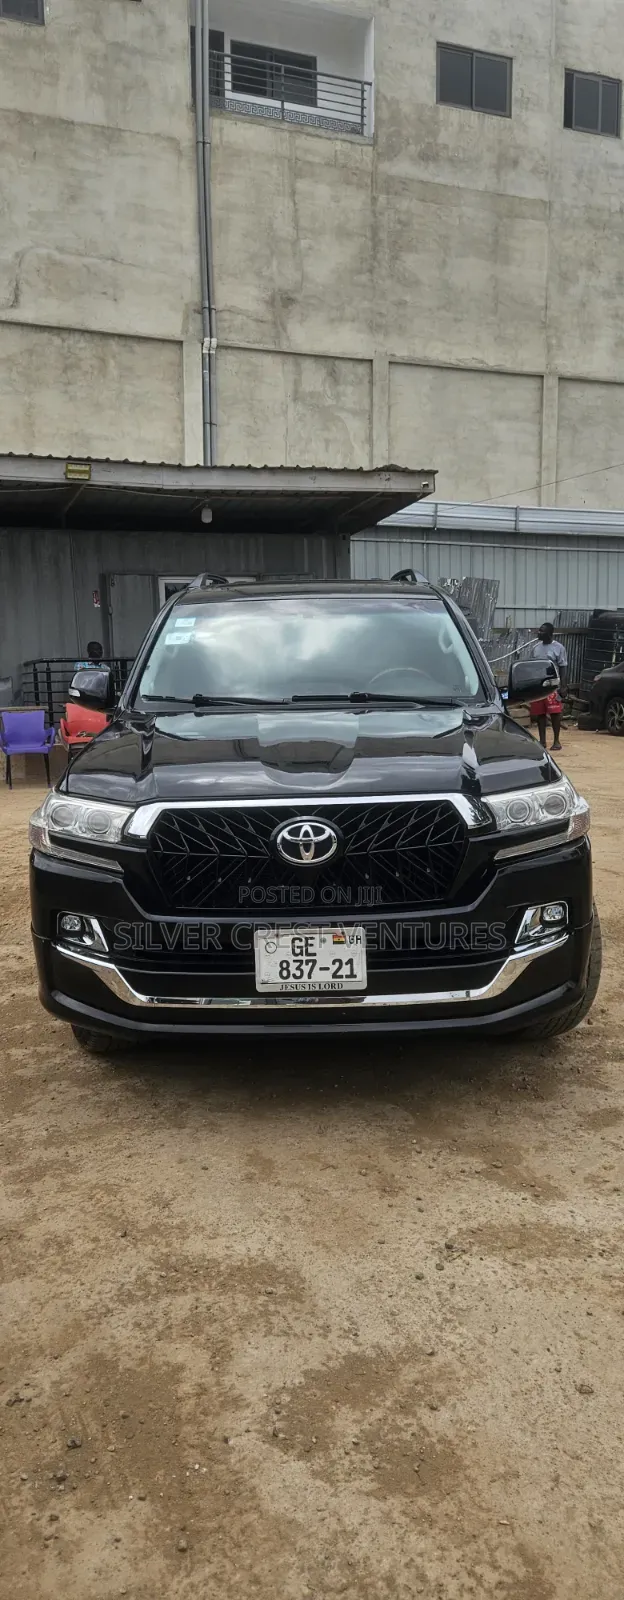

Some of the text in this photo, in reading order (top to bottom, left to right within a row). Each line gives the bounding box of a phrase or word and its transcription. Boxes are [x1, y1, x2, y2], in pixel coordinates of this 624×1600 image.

[291, 936, 317, 957] GE
[348, 935, 362, 944] GH
[278, 958, 357, 980] 837-21
[318, 982, 344, 990] LORD
